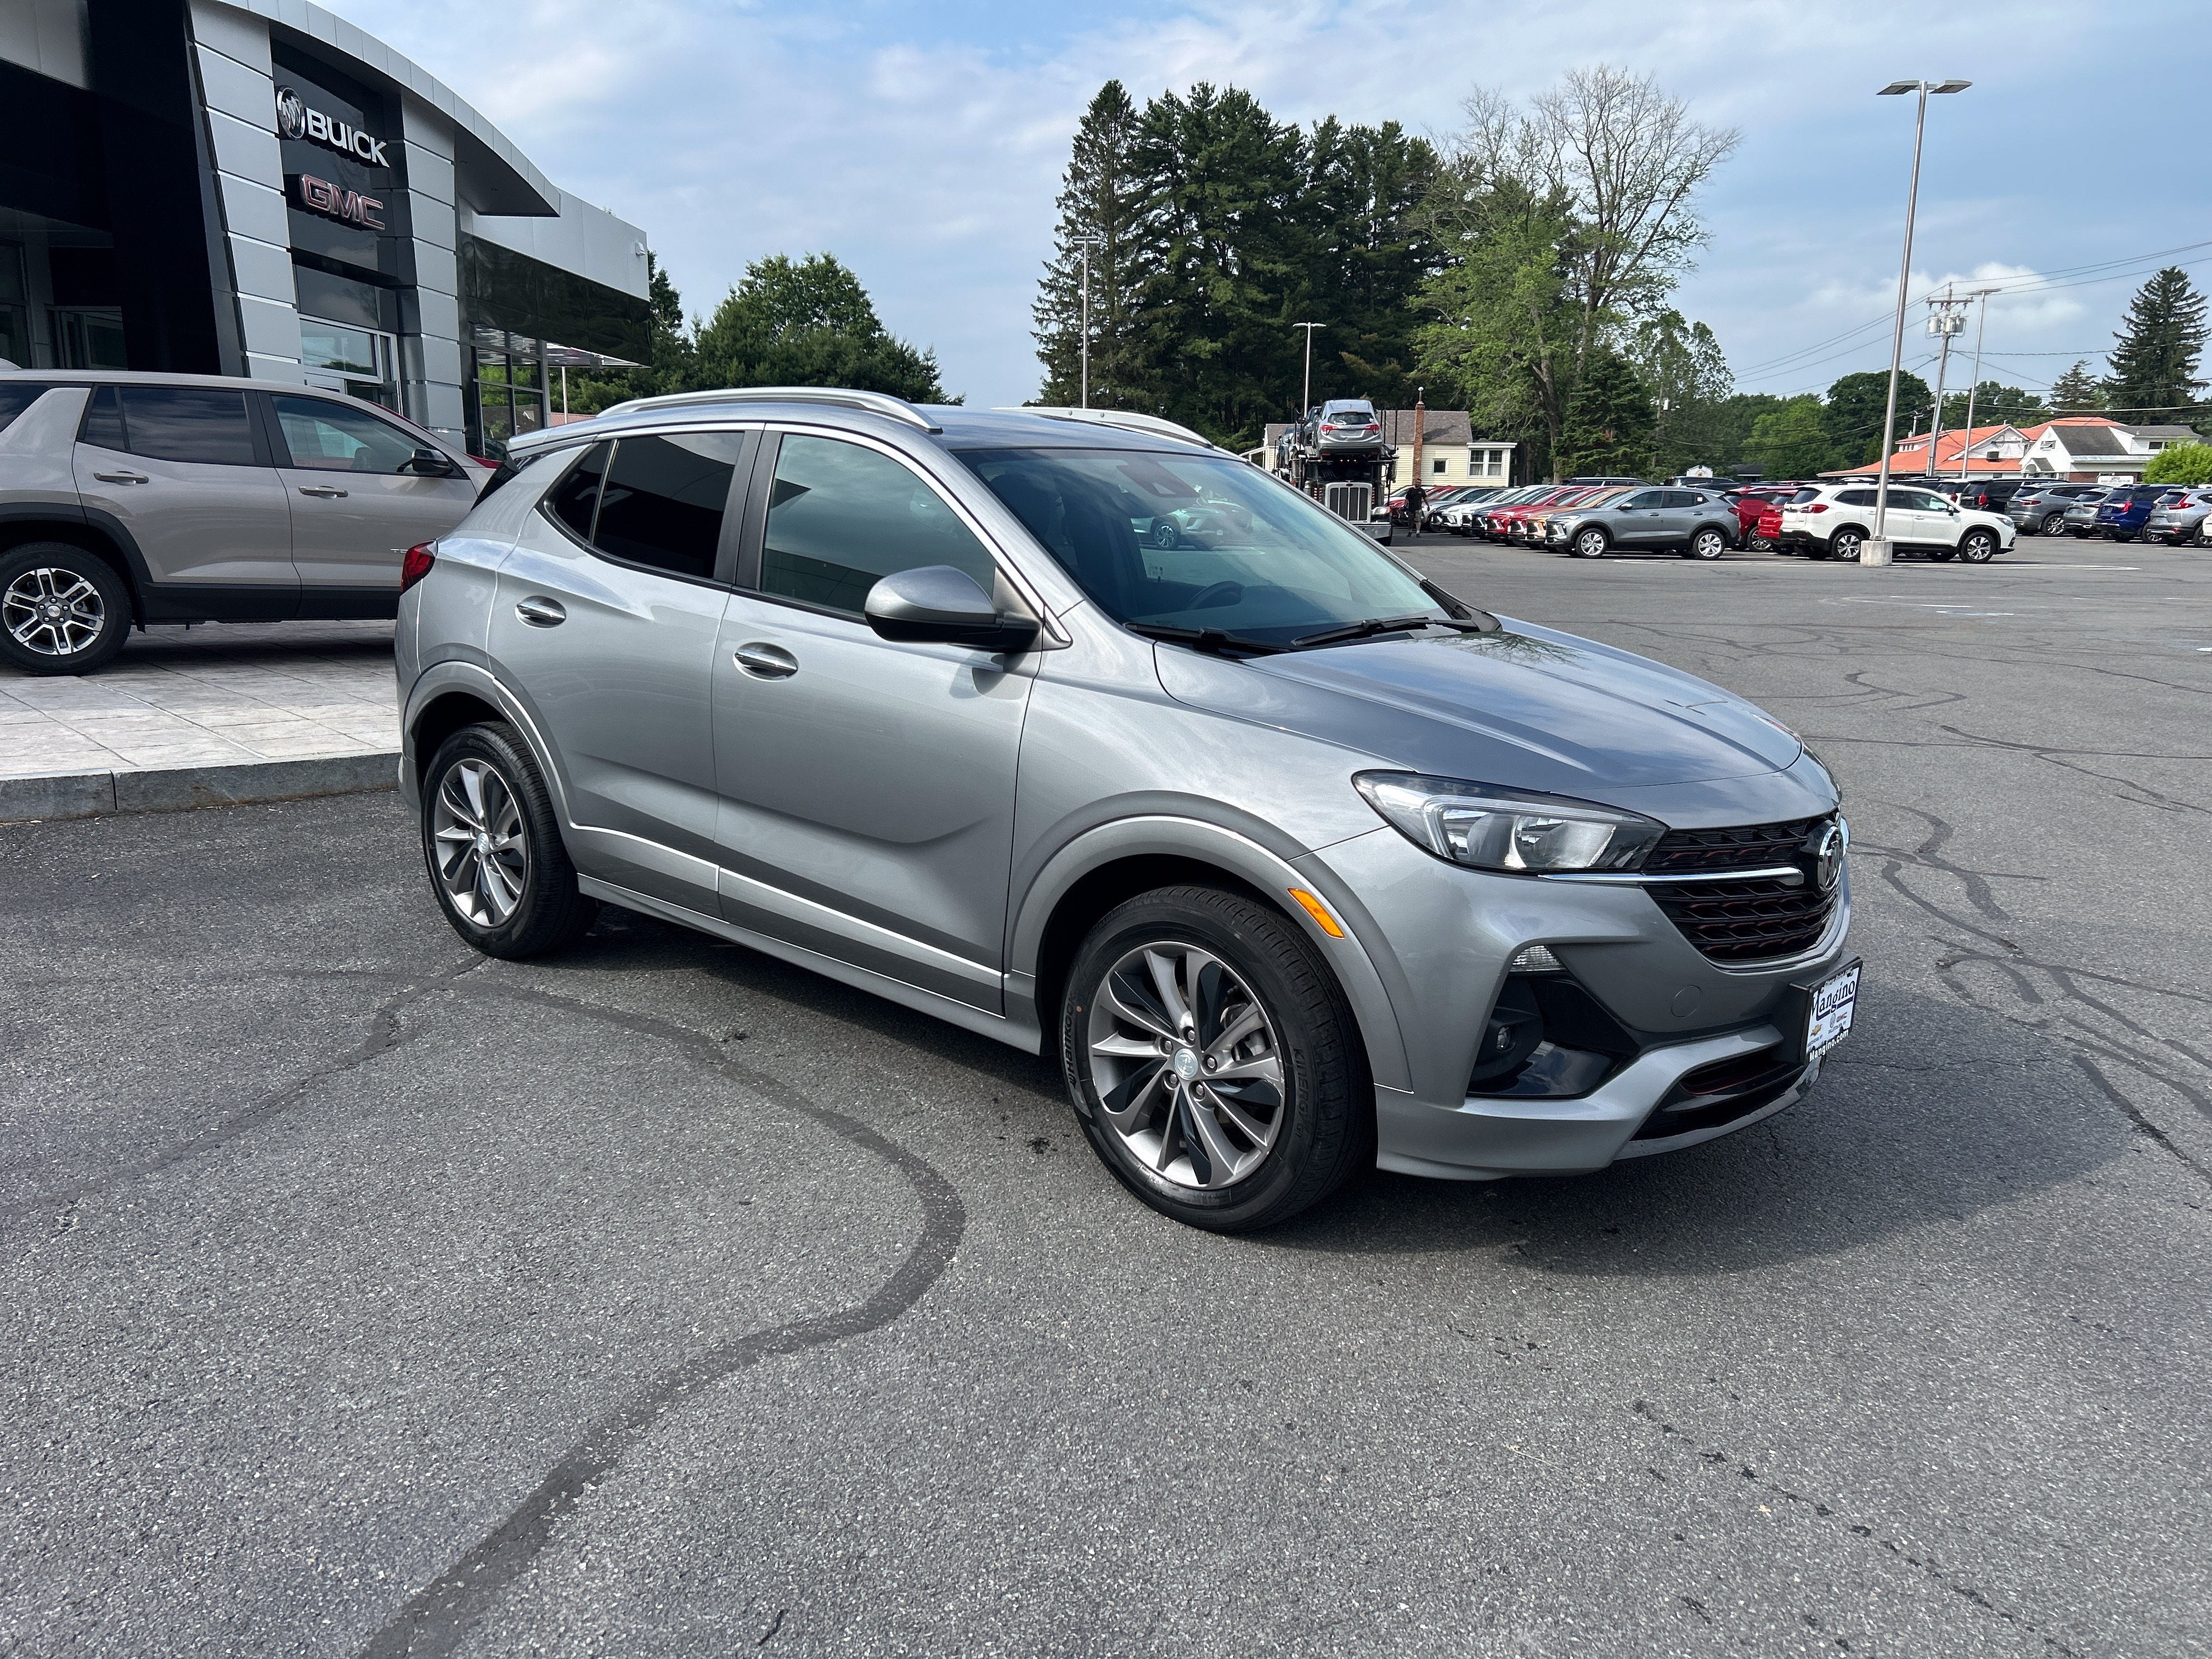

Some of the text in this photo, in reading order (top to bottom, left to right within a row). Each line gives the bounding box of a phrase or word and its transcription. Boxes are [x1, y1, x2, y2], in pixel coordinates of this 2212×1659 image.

[306, 107, 390, 168] BUICK
[300, 174, 385, 230] GMC
[1809, 1029, 1849, 1062] Mangino.com
